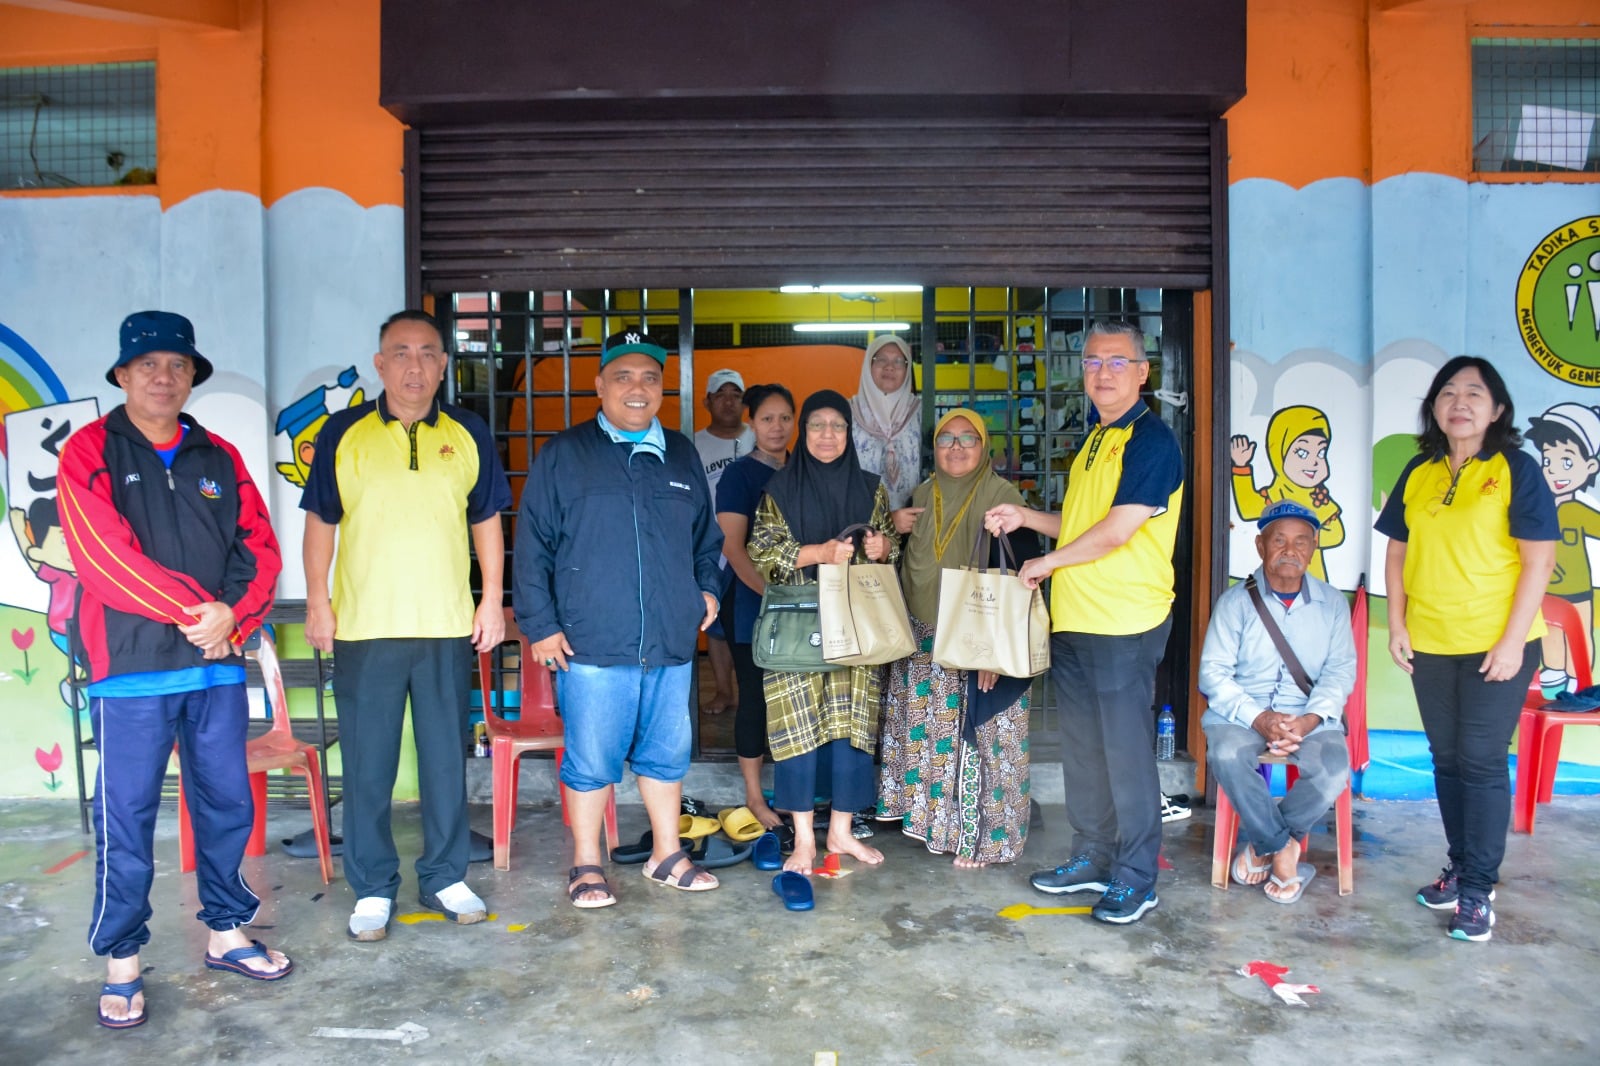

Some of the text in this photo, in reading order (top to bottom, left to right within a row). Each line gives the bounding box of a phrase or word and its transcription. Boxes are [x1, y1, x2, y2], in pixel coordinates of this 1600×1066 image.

[1527, 227, 1580, 272] TADIKA
[624, 332, 641, 345] NY
[1521, 308, 1564, 375] MEMBENTUK
